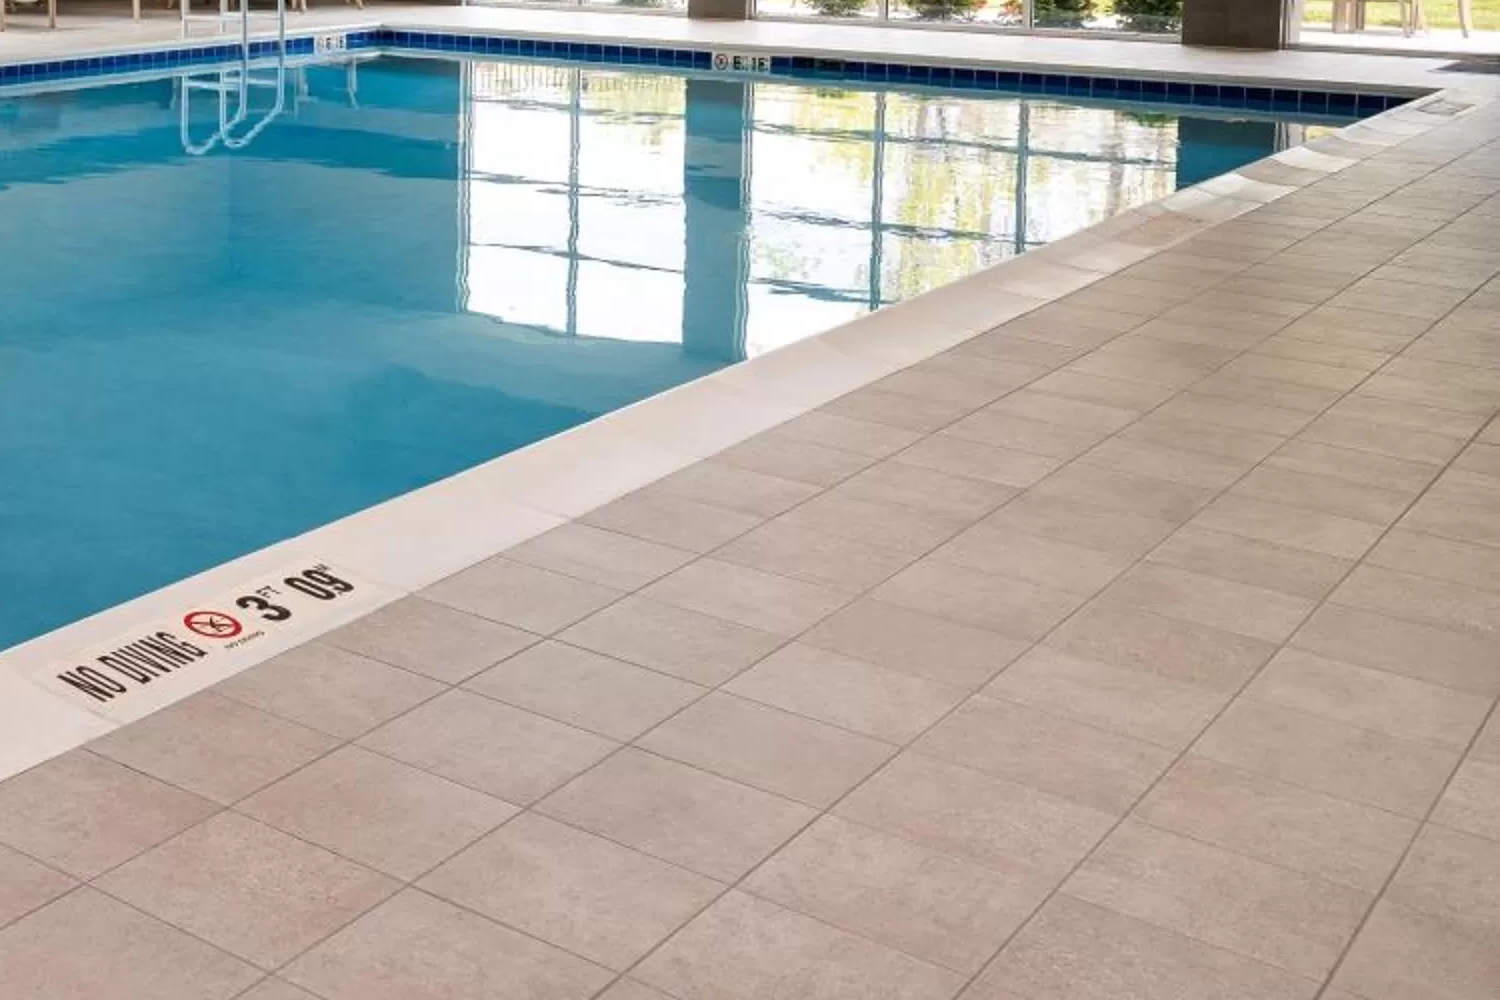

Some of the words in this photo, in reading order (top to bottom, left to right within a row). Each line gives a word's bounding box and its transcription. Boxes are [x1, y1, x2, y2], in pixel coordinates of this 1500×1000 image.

[236, 595, 292, 622] 3
[284, 569, 354, 601] 09
[57, 665, 127, 703] NO
[96, 631, 208, 685] DIVING
